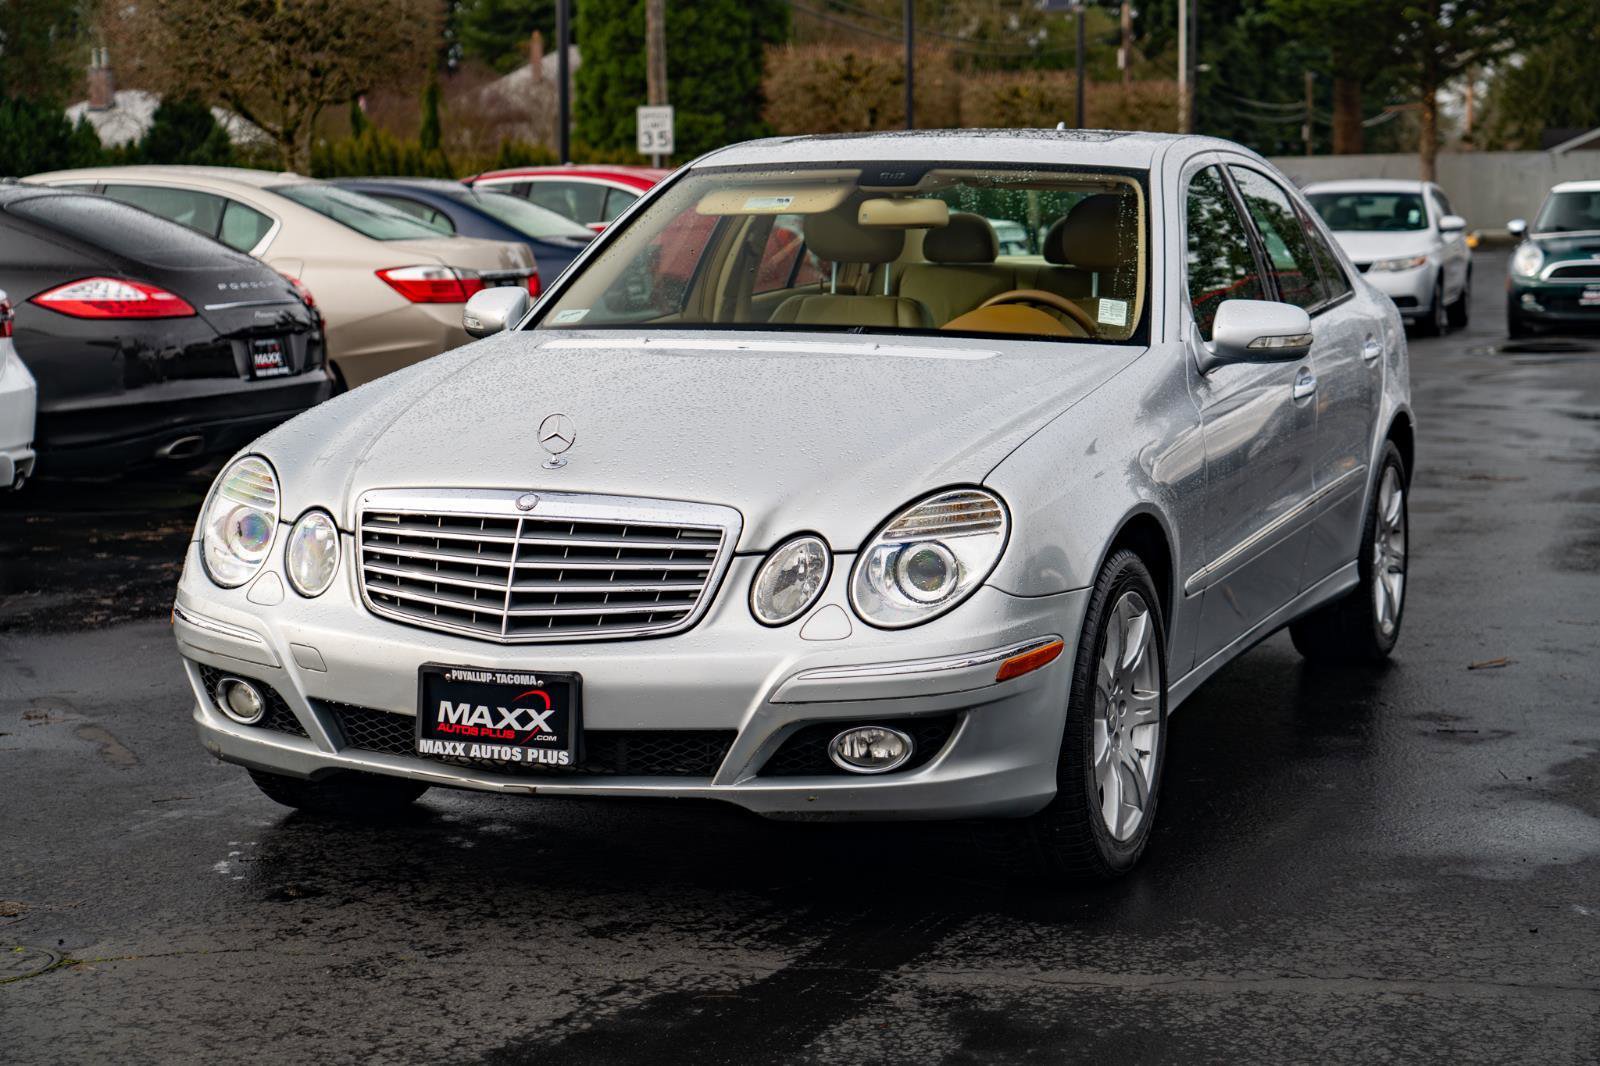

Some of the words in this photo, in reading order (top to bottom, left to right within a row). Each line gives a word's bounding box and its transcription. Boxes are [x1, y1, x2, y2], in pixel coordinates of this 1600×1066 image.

[642, 130, 668, 148] 35
[437, 700, 555, 733] MAXX
[437, 722, 479, 737] AUTOS
[481, 727, 516, 739] PLUS
[419, 739, 466, 757] MAXX
[469, 744, 522, 762] AUTOS
[527, 748, 569, 766] PLUS
